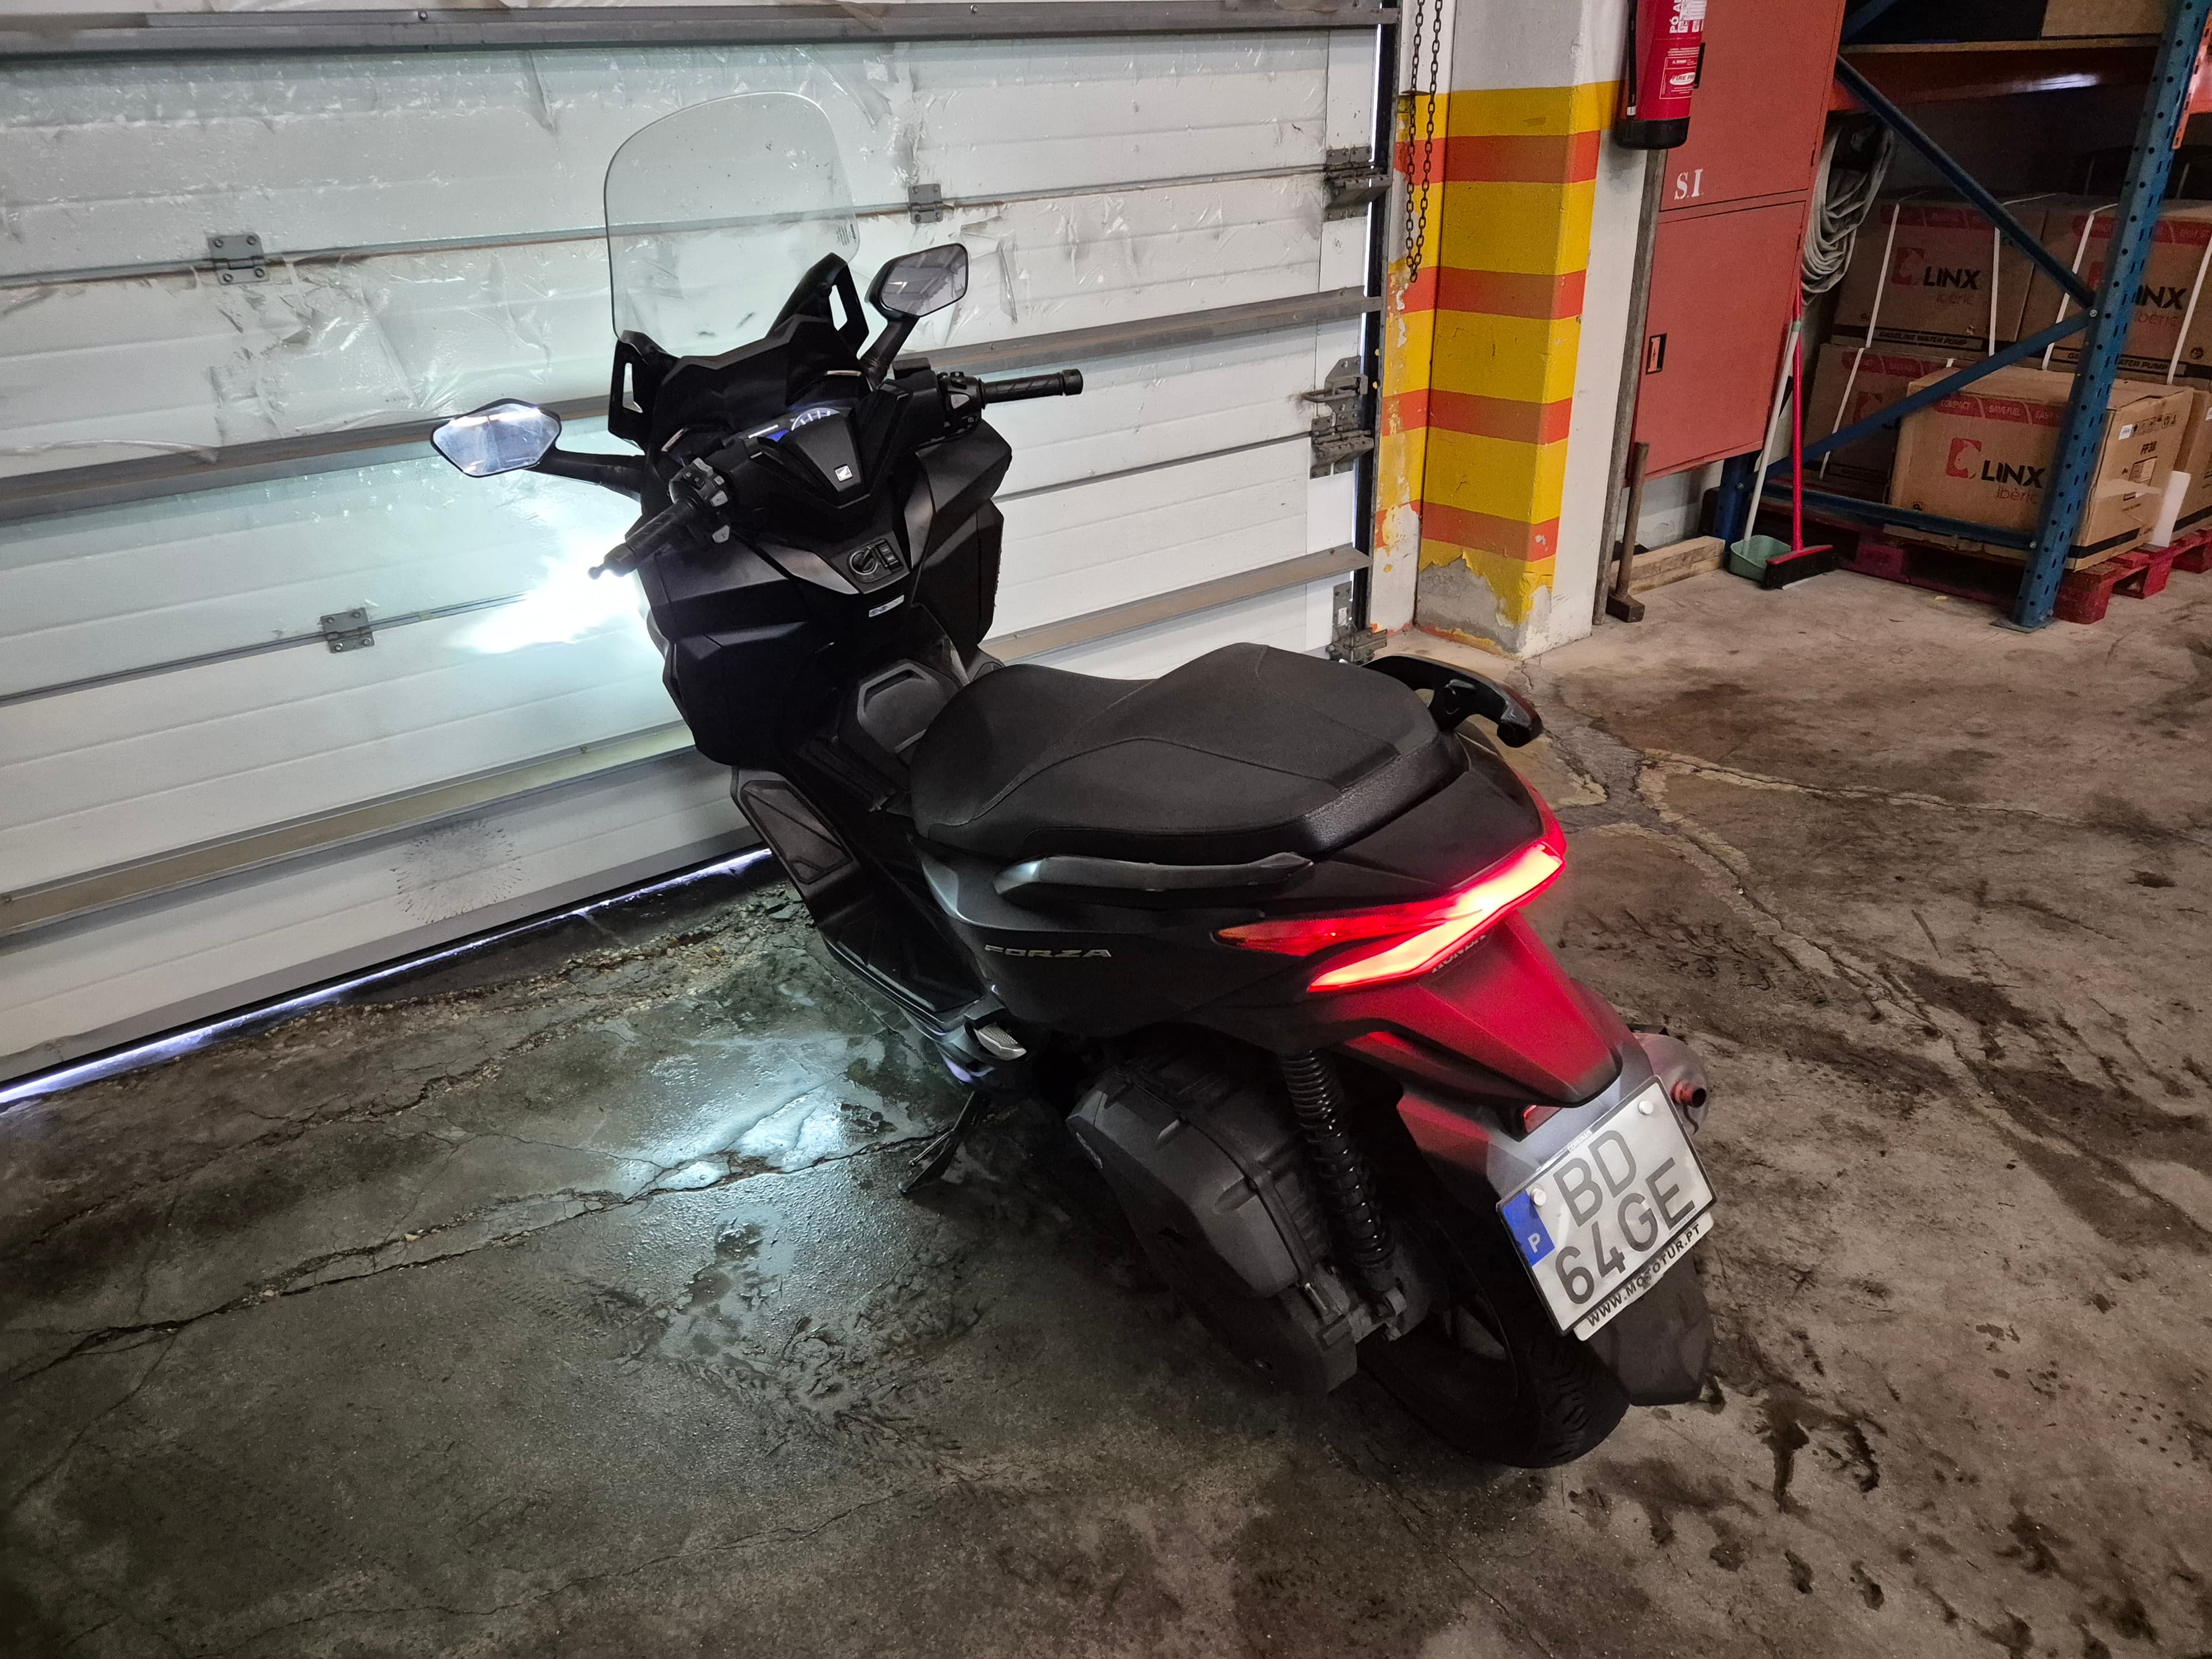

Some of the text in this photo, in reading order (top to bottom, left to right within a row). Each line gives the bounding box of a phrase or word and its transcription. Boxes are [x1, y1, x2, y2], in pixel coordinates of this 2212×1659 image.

[1923, 266, 1982, 290] LINX
[2135, 284, 2187, 310] INX
[2118, 358, 2168, 370] ATER PUMP
[1980, 460, 2046, 489] LINX
[984, 944, 1112, 958] FORZA
[1554, 1130, 1637, 1227] BD
[1528, 1233, 1540, 1253] P
[1555, 1157, 1695, 1304] 64GE
